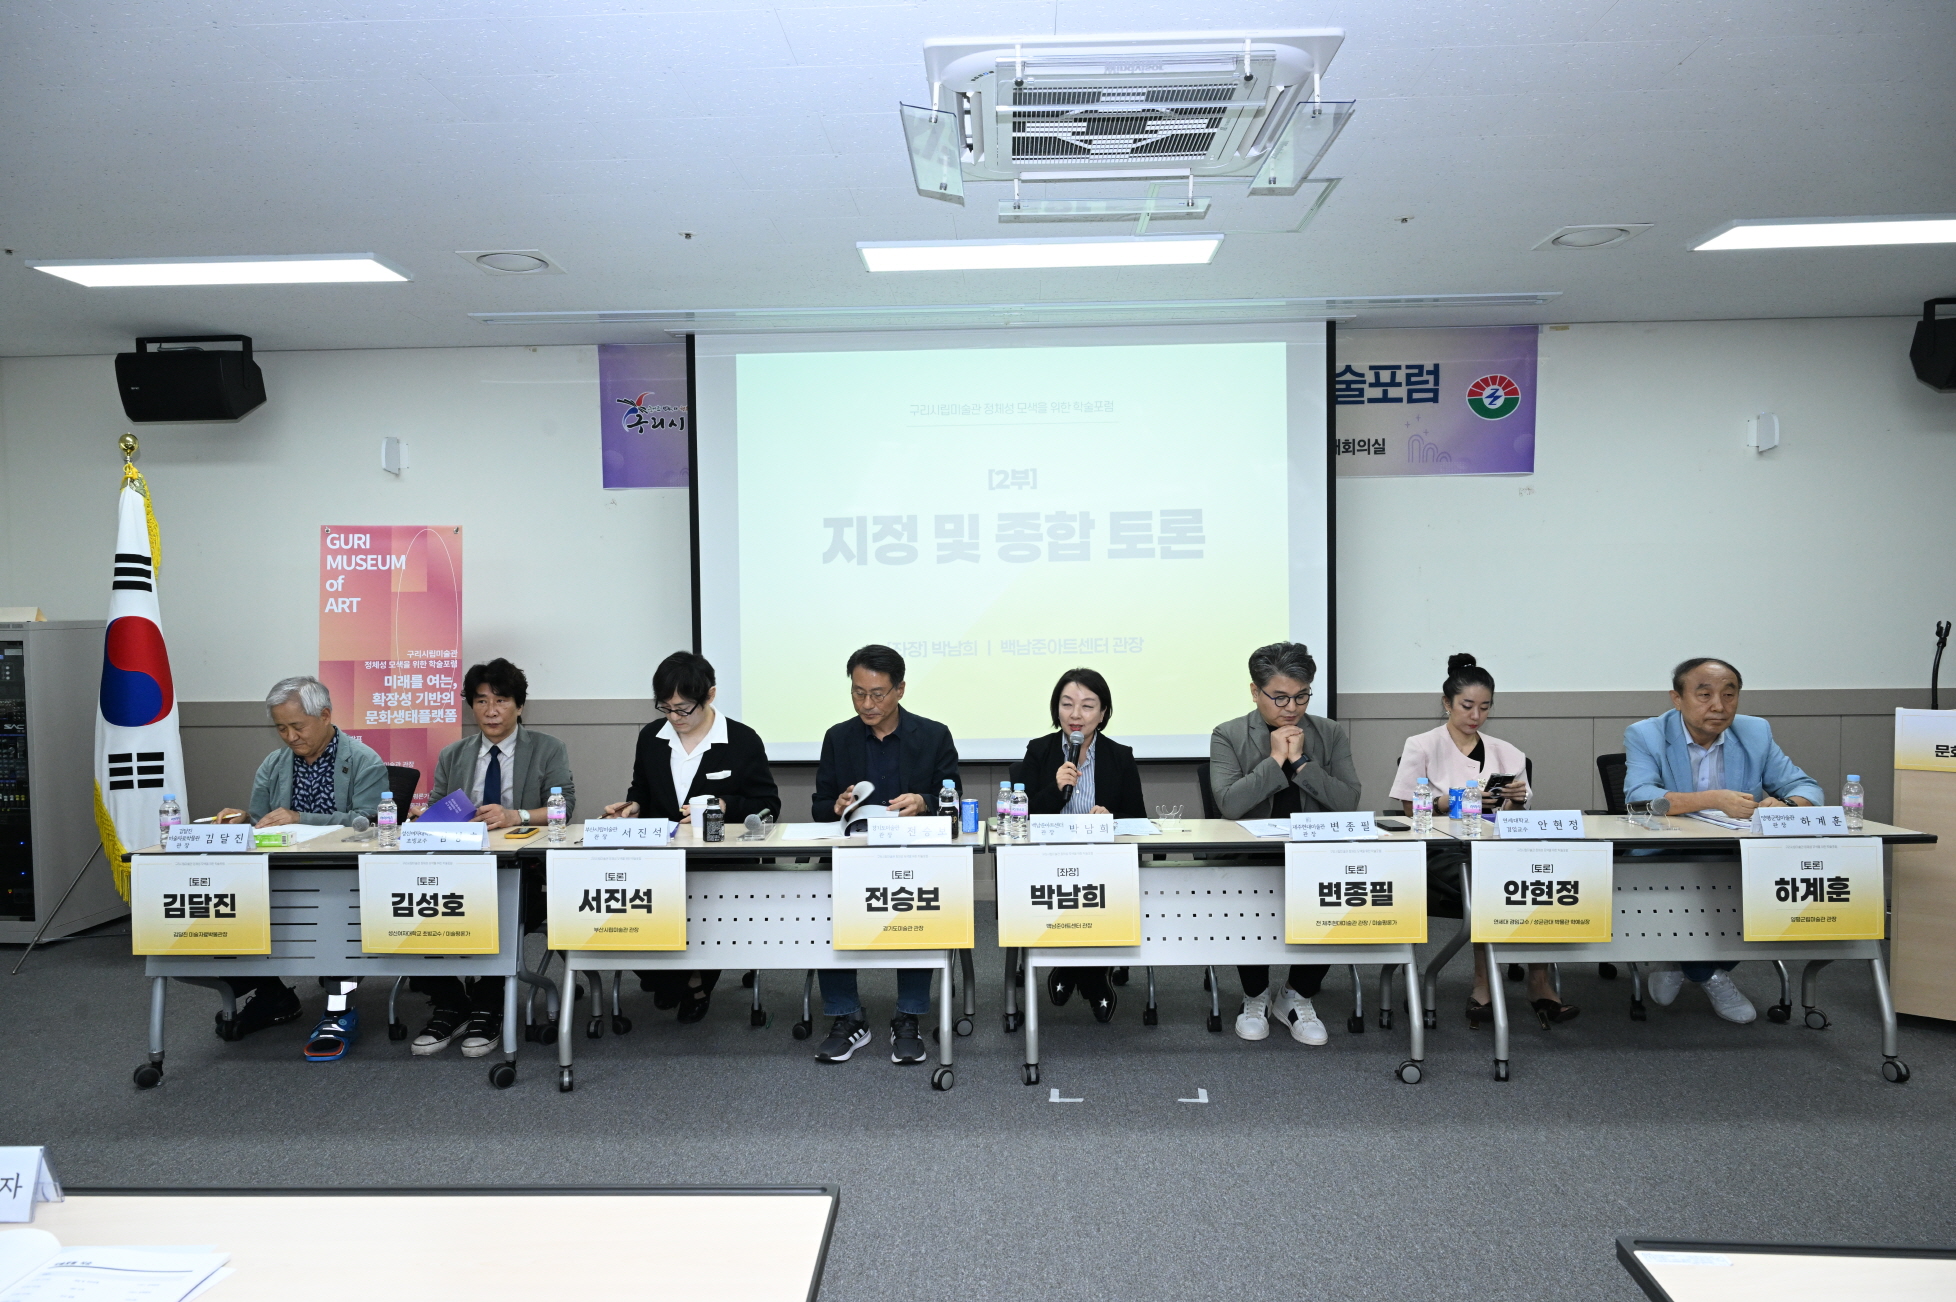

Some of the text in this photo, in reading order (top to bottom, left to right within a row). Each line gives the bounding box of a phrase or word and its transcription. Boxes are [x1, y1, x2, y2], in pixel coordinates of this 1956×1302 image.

[1336, 363, 1440, 405] 술포럼
[909, 400, 1114, 416] 구리시립미술관 정체성 모색을 위한 학술포럼
[627, 413, 685, 434] 구리시
[988, 468, 1038, 491] [2부]
[326, 534, 370, 549] GURI
[822, 508, 1206, 566] 지정 및 종합 토론
[326, 555, 406, 570] MUSEUM
[325, 575, 345, 591] of
[324, 598, 361, 613] ART
[407, 650, 458, 658] 구리시립미술관
[932, 640, 977, 657] 박남희
[1000, 638, 1109, 656] 백남준아트센터
[1112, 636, 1144, 654] 관장
[364, 659, 458, 669] 정체성 모색을 위한 학술포럼
[384, 674, 457, 689] 미래를 여는,
[372, 691, 454, 706] 확장성 기반의
[365, 708, 457, 725] 문화생태플랫폼
[1057, 867, 1079, 877] [좌장]
[1345, 865, 1368, 875] [토론]
[1531, 864, 1554, 873] [토론]
[1801, 861, 1823, 870] [토론]
[189, 877, 211, 886] [토론]
[417, 876, 439, 886] [토론]
[605, 872, 627, 882] [토론]
[891, 870, 914, 880] [토론]
[1030, 884, 1106, 910] 박남희
[1318, 881, 1394, 907] 변종필
[1504, 880, 1579, 906] 안현정
[1774, 876, 1851, 902] 하계훈
[163, 893, 236, 918] 김달진
[391, 892, 465, 918] 김성호
[578, 889, 653, 914] 서진석
[865, 886, 941, 912] 전승보
